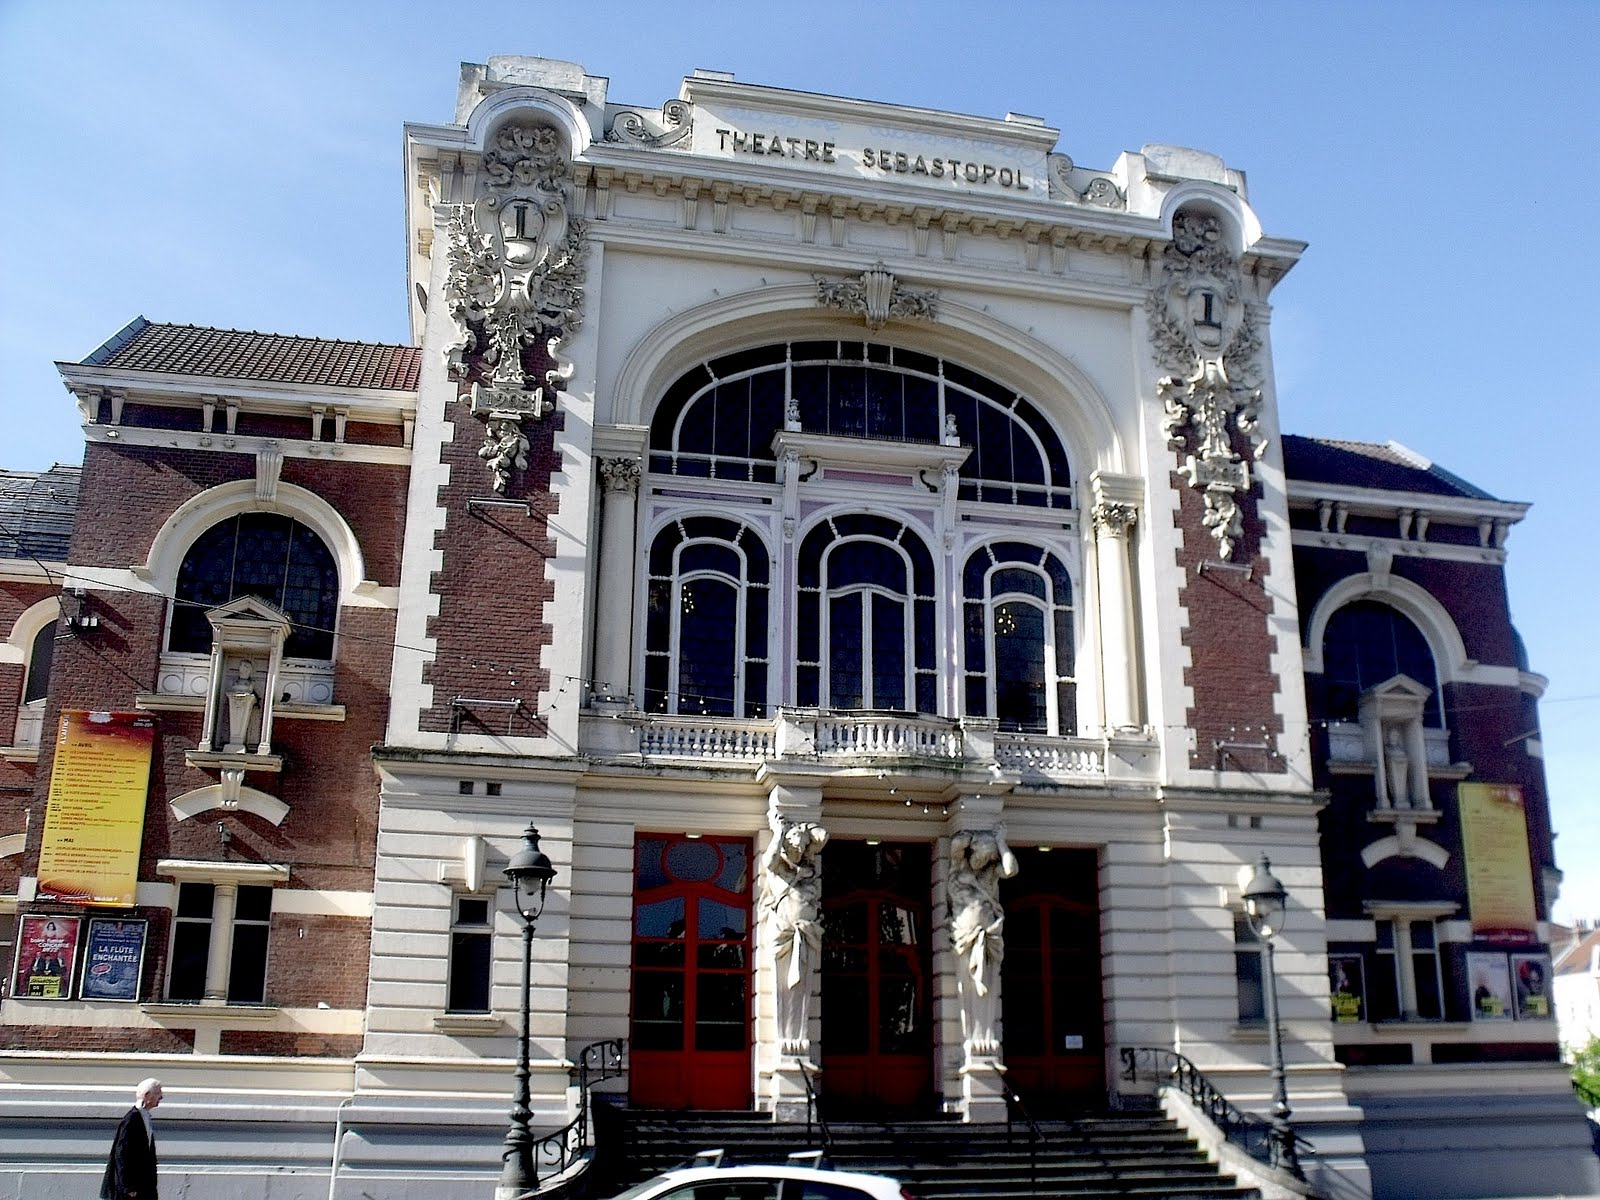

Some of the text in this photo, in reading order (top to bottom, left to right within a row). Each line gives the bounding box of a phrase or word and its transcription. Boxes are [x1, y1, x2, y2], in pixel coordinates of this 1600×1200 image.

[716, 128, 1029, 190] THEATRE SEBASTOPOL
[98, 945, 109, 953] LA
[92, 953, 138, 962] ENCHANTÉE
